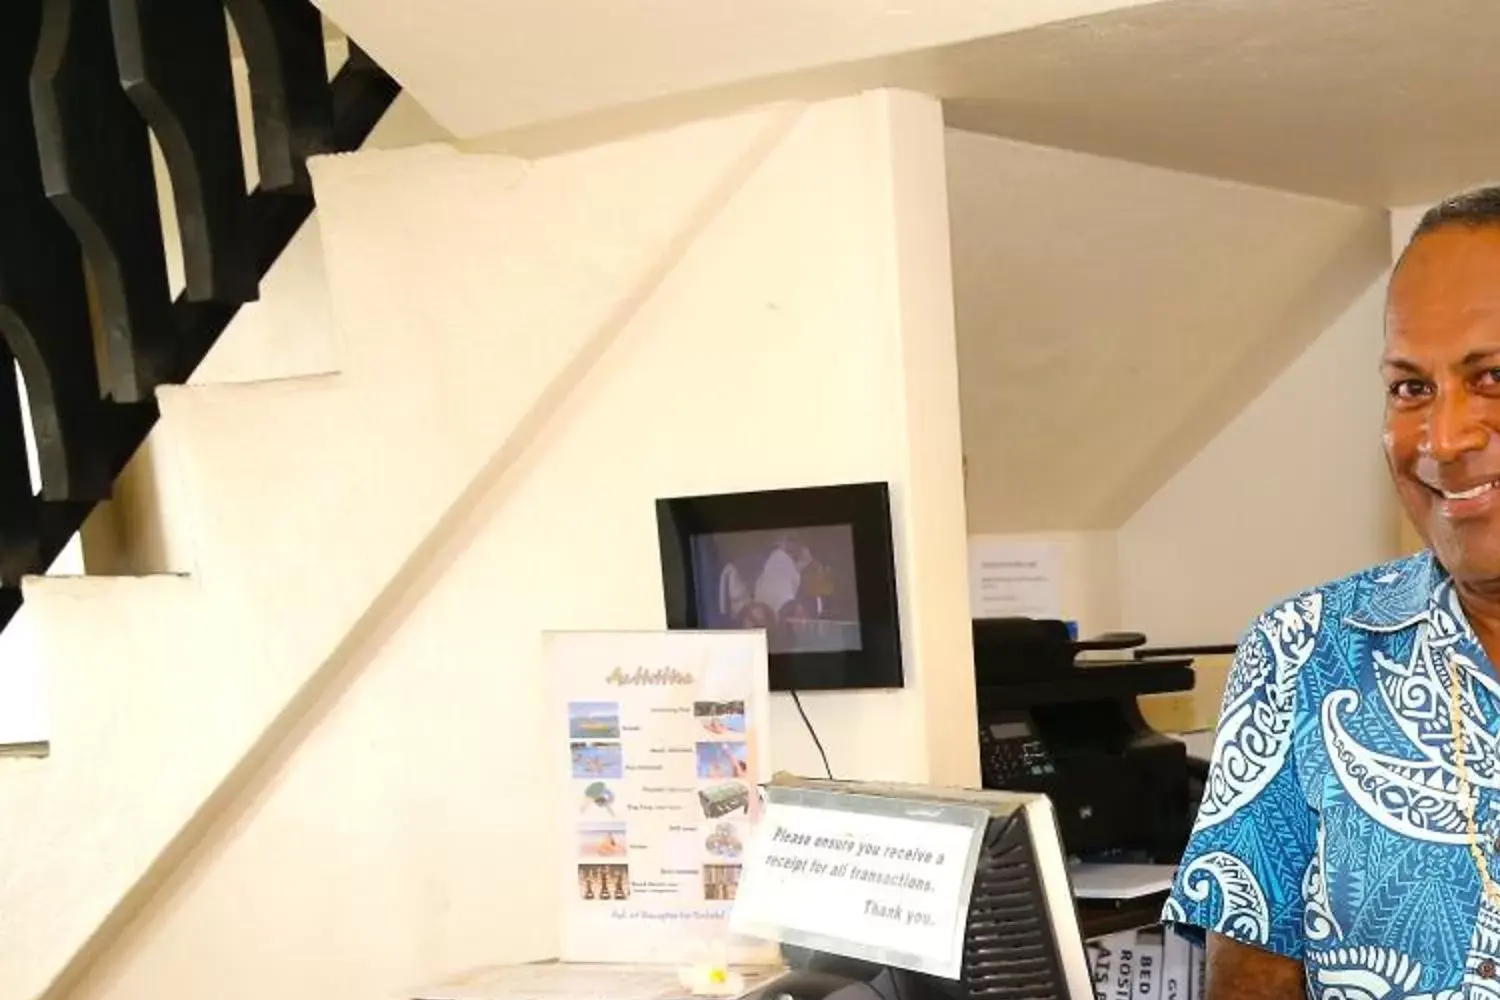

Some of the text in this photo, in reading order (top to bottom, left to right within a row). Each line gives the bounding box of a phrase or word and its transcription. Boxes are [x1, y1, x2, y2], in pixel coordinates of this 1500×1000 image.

[772, 826, 945, 866] Please ensure you receive a
[765, 854, 935, 893] receipt for all transactions.
[863, 900, 936, 927] Thank you.
[1139, 956, 1153, 995] BED
